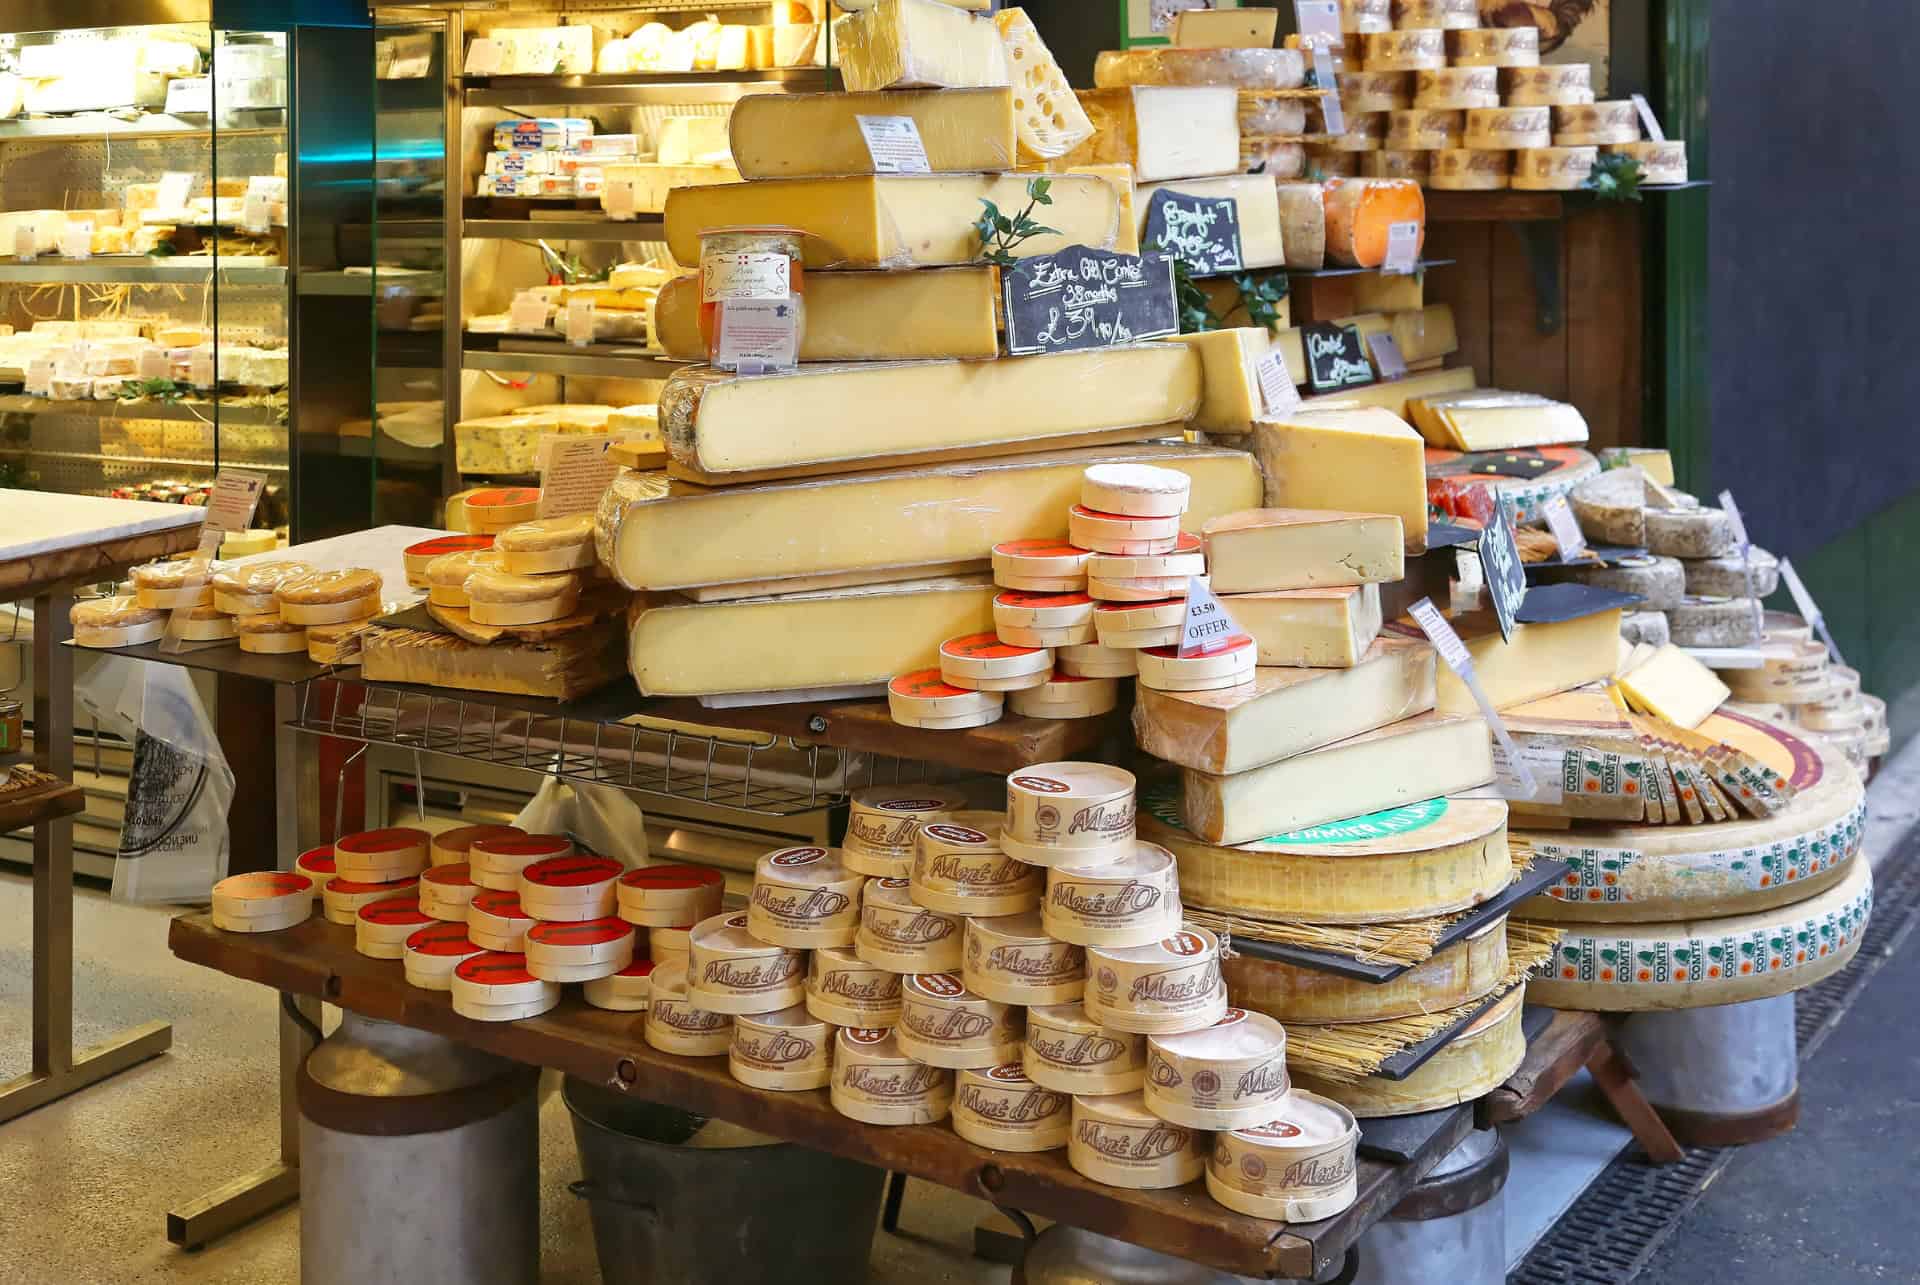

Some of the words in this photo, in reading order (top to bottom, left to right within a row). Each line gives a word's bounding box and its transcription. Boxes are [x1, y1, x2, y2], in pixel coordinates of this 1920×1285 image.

[1029, 261, 1079, 288] Extra
[1080, 256, 1102, 281] Old
[1063, 284, 1085, 304] 38
[1191, 602, 1216, 617] £3.50
[1188, 618, 1231, 639] OFFER
[1105, 879, 1161, 913] d'Or
[1619, 940, 1630, 982] COMTE
[1656, 941, 1666, 983] COMTE
[1691, 939, 1700, 981] COMTE
[934, 1006, 993, 1040] d'Or
[759, 1031, 816, 1065] d'Or
